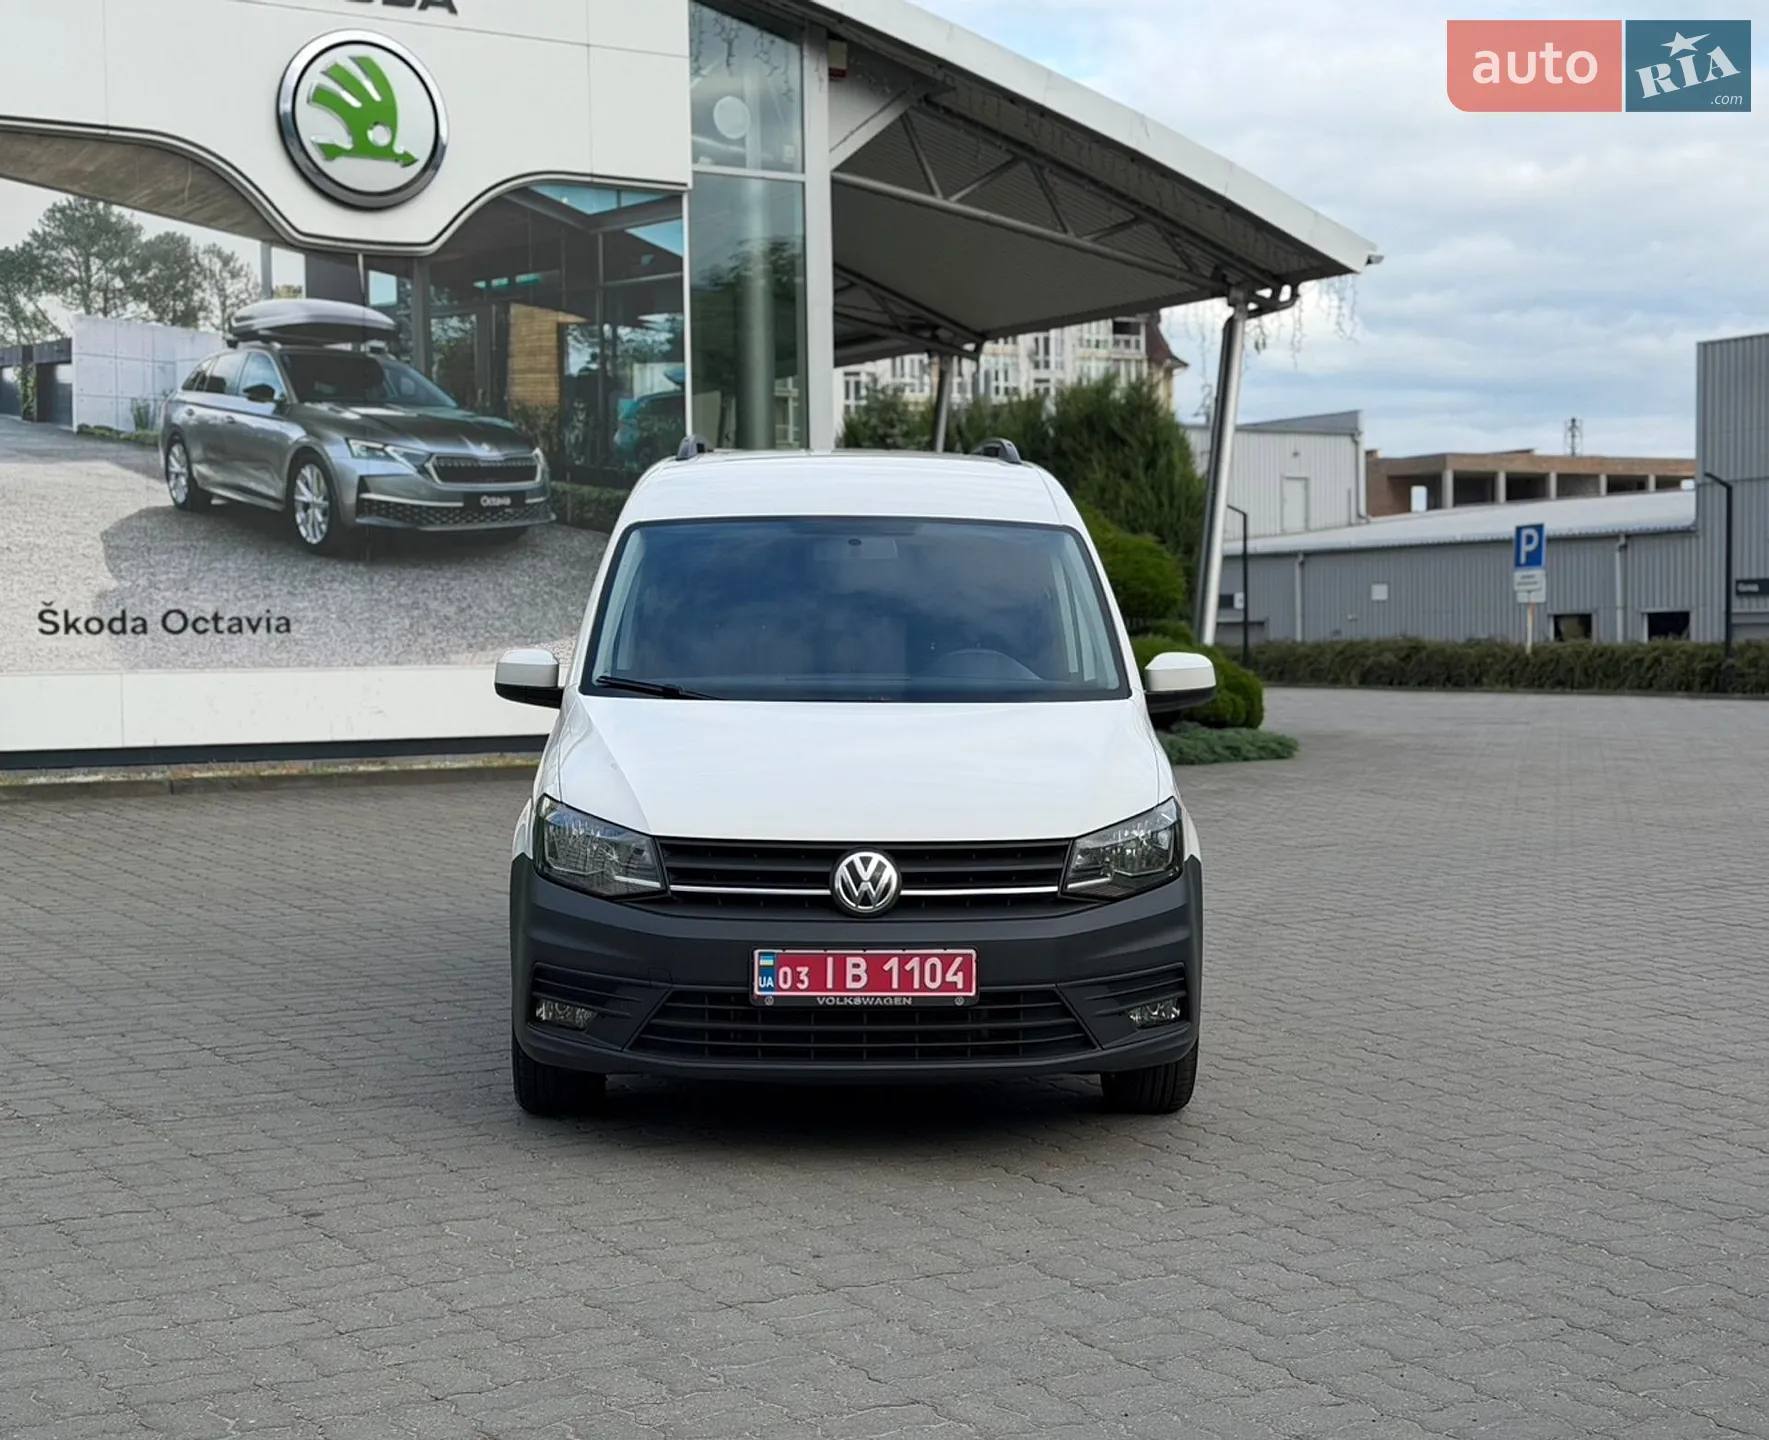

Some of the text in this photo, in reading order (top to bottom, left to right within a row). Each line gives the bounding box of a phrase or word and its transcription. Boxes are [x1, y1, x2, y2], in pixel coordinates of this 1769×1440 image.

[1520, 528, 1539, 565] P
[37, 600, 292, 636] Škoda Octavia
[758, 956, 964, 990] UA 03 IB 1104
[816, 996, 913, 1006] VOLKSWAGEN
